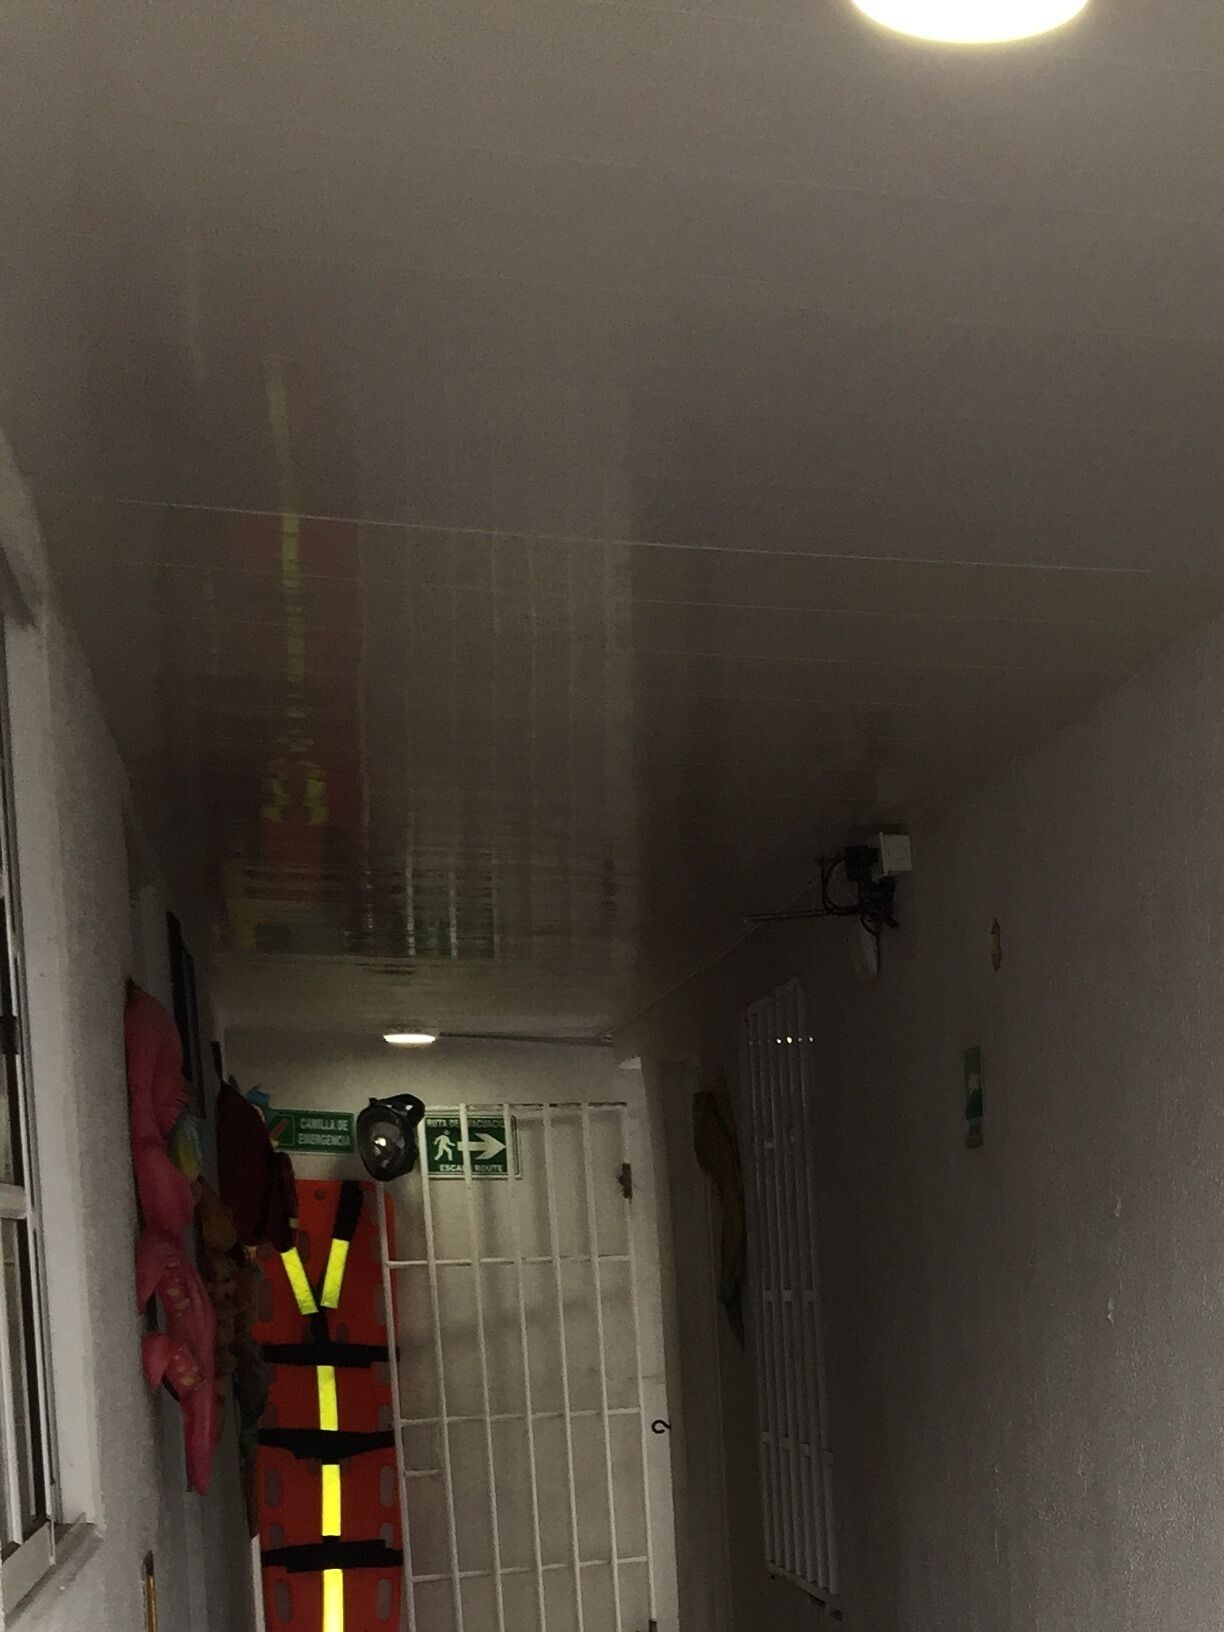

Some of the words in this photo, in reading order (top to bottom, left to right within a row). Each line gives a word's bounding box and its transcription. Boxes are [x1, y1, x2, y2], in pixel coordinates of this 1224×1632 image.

[300, 1118, 335, 1129] CAMILLA
[337, 1119, 348, 1131] DE
[474, 1164, 503, 1172] ROUTE
